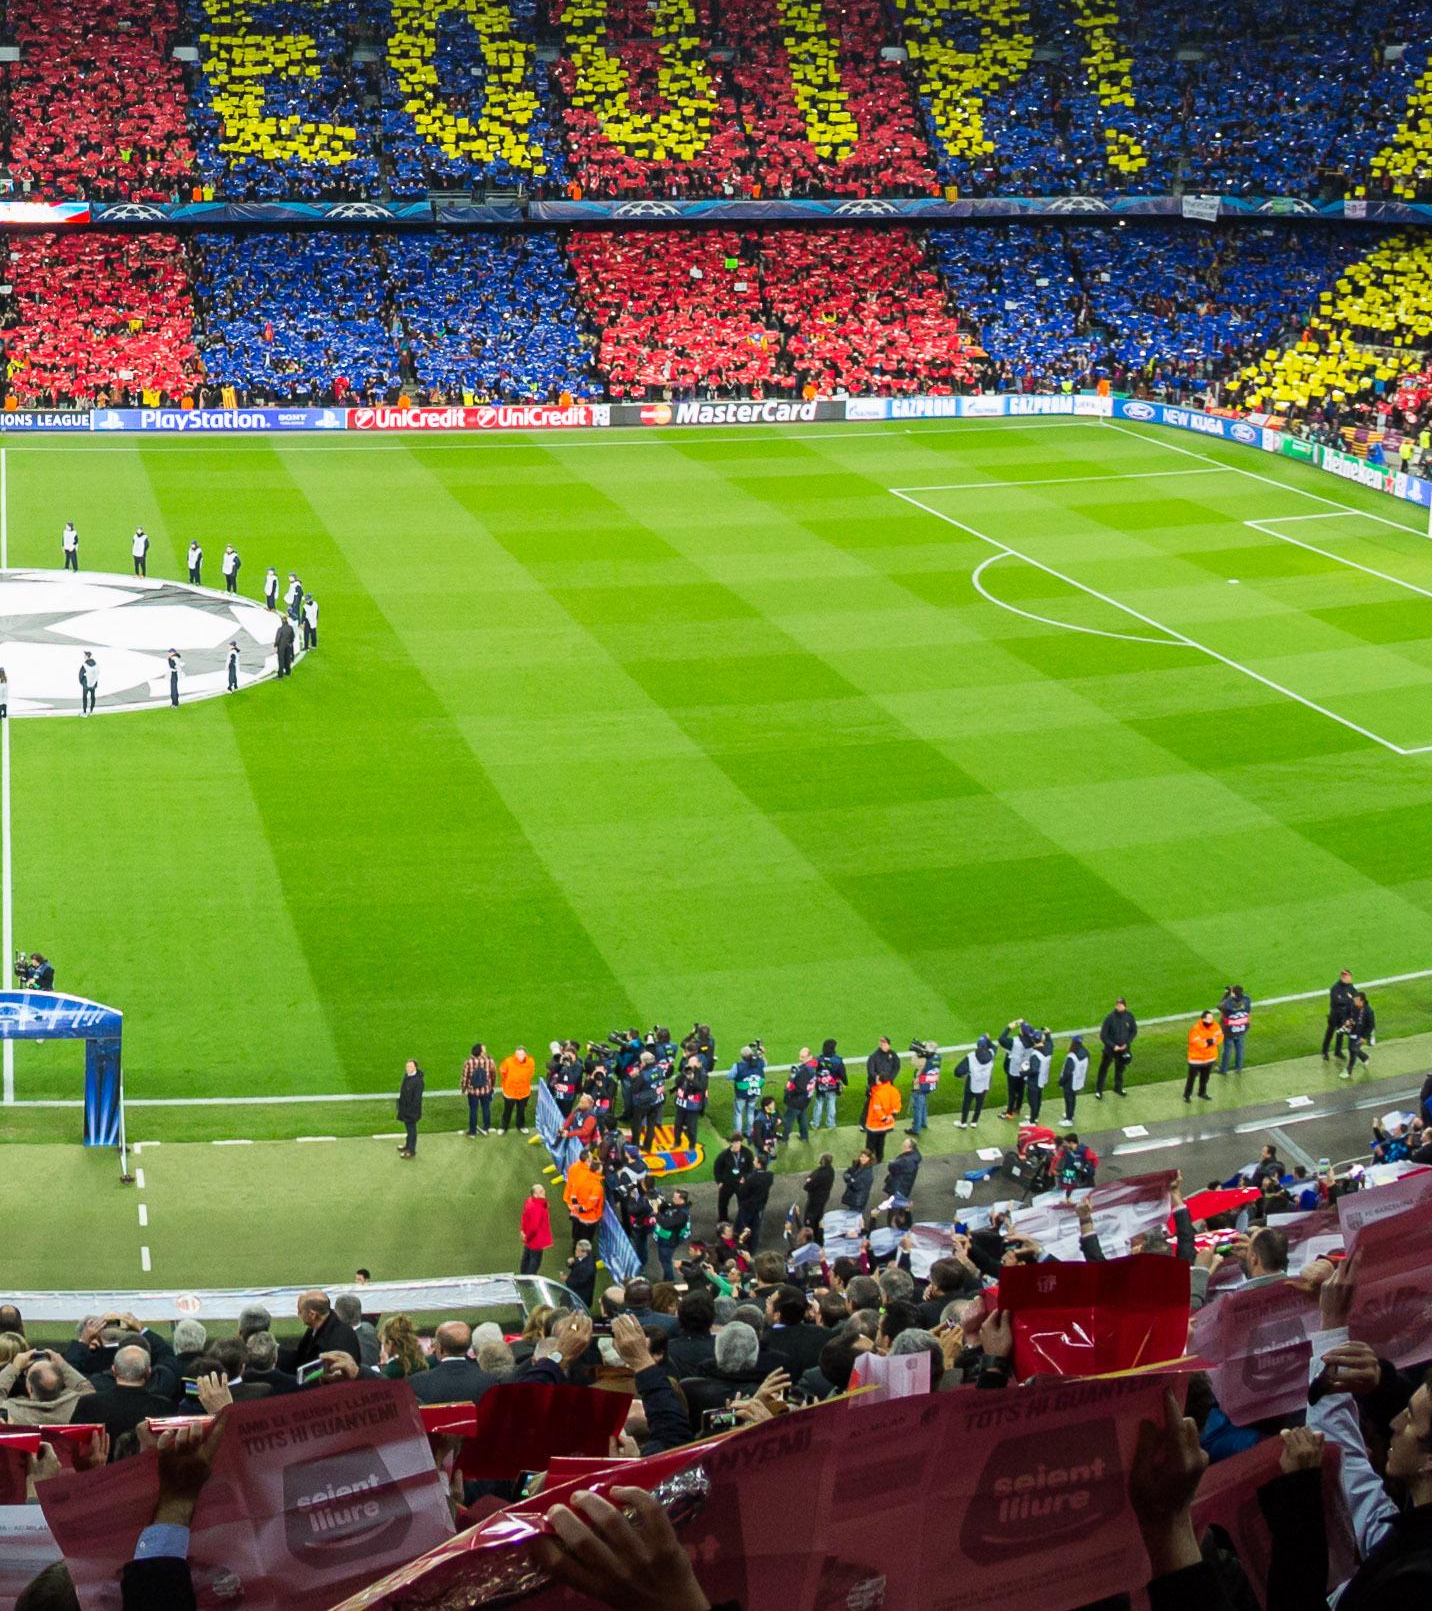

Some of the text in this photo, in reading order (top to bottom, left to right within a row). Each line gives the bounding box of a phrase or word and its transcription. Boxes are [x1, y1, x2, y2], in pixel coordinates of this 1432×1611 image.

[376, 407, 586, 428] UniCredit UniCredit
[677, 400, 818, 424] MasterCard
[892, 399, 956, 417] GAZPROM
[1009, 395, 1074, 415] GAZPROM
[38, 414, 91, 427] LEAGUE
[141, 410, 266, 431] PlayStation
[1163, 408, 1188, 426] NEW
[1190, 415, 1224, 436] KUGA
[1322, 449, 1382, 491] Heineken
[237, 1415, 271, 1438] AMB
[966, 1403, 1020, 1433] TOTS
[245, 1430, 287, 1456] TOTS
[289, 1426, 309, 1447] HI
[296, 1472, 381, 1509] seient
[993, 1457, 1105, 1497] seient
[309, 1499, 381, 1534] lliure
[998, 1490, 1090, 1524] lliure
